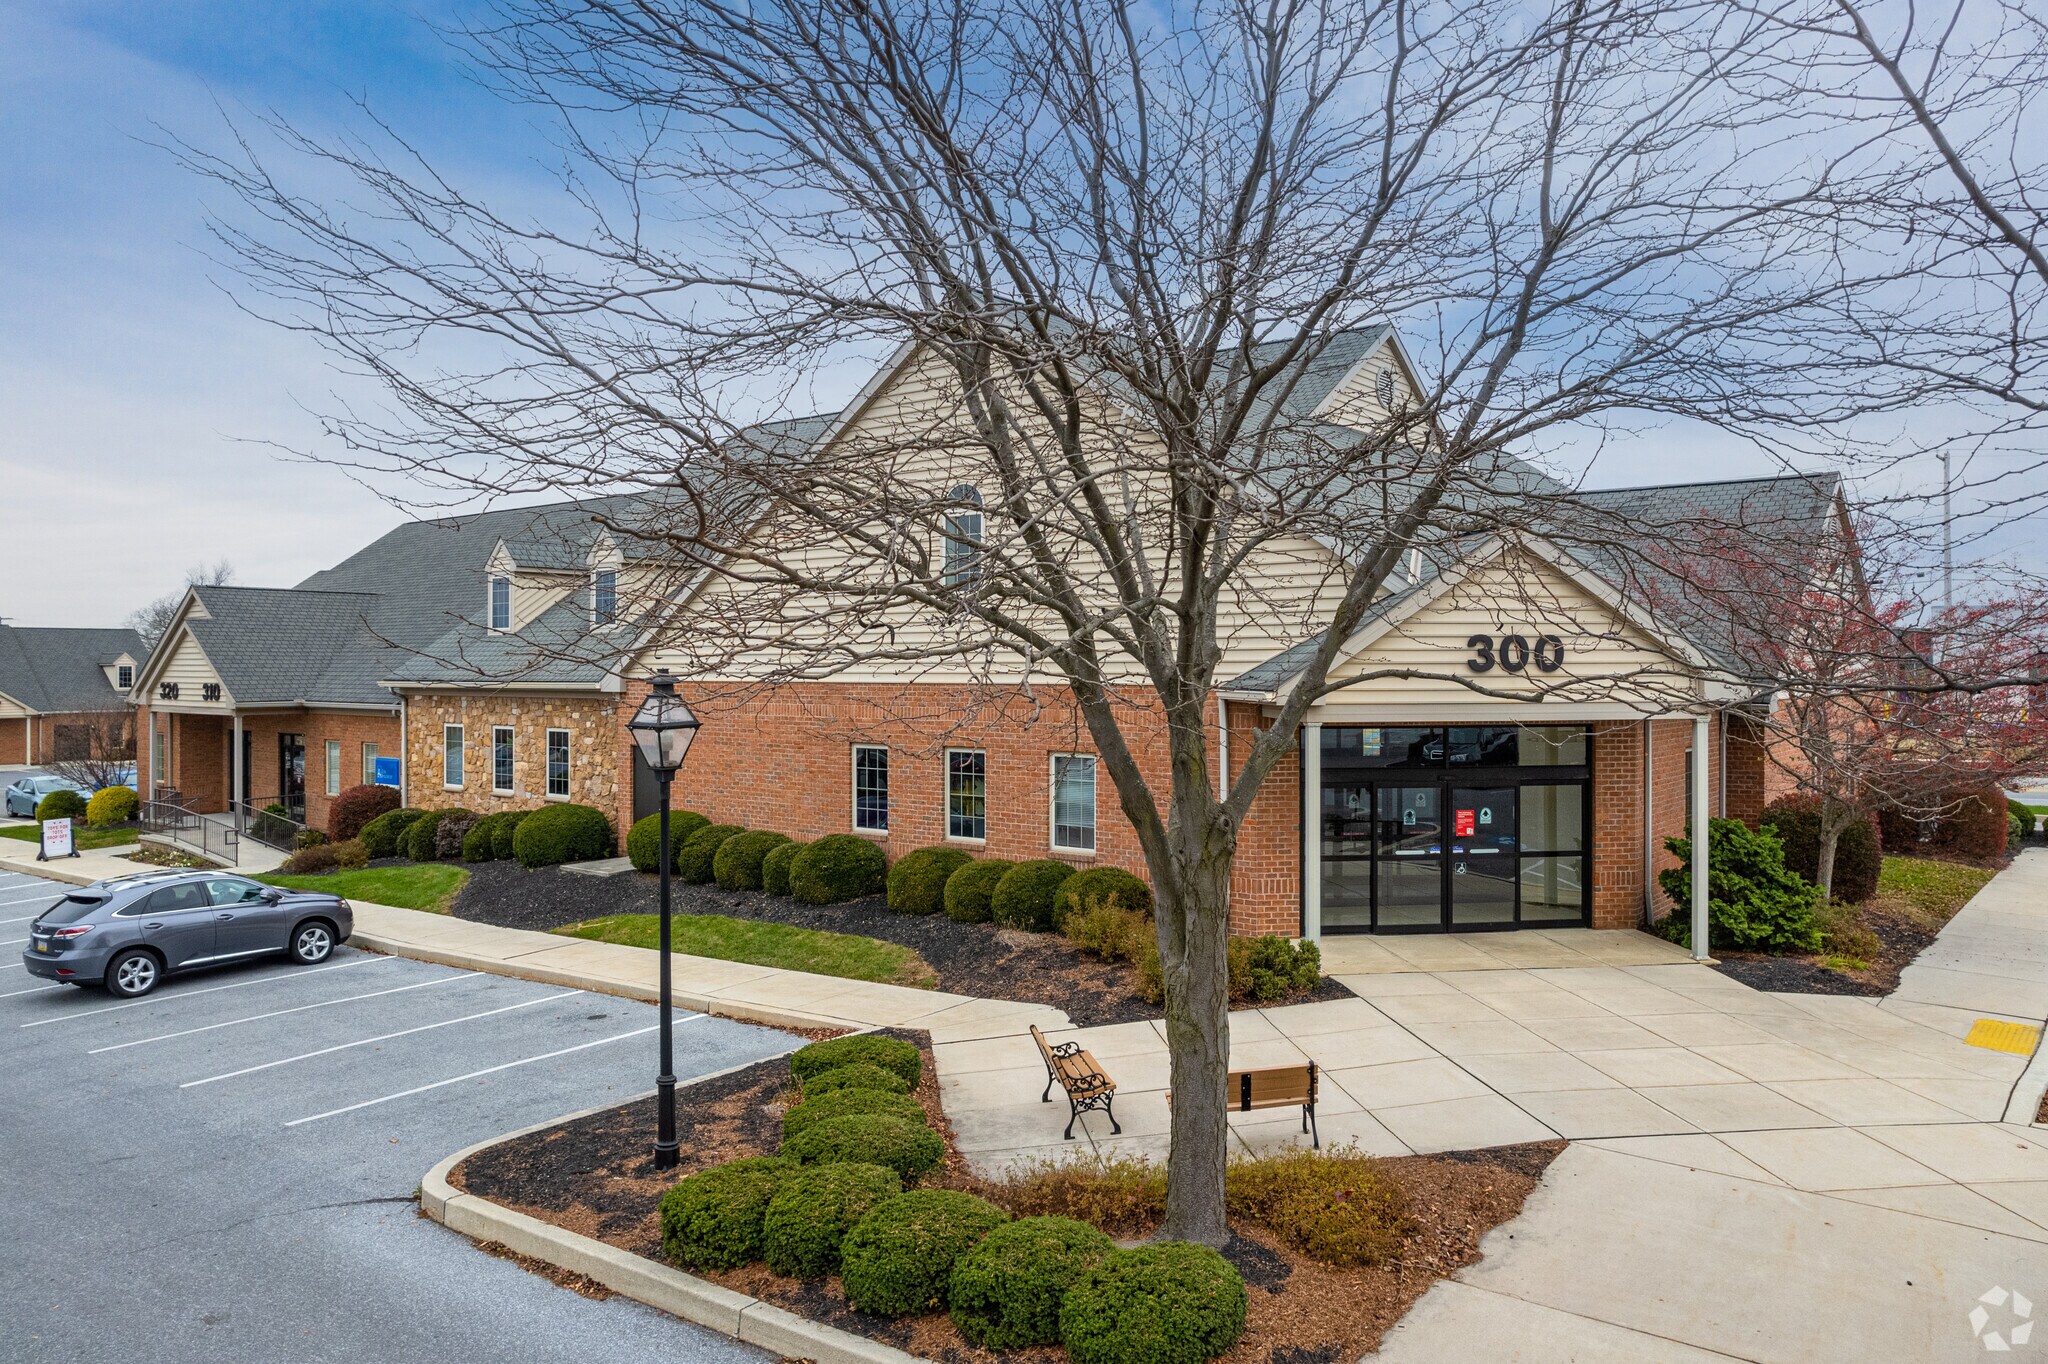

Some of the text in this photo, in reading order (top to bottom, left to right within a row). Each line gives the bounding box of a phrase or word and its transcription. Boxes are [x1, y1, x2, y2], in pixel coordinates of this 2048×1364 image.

[1467, 634, 1564, 673] 300
[160, 682, 179, 700] 320
[202, 683, 220, 701] 310
